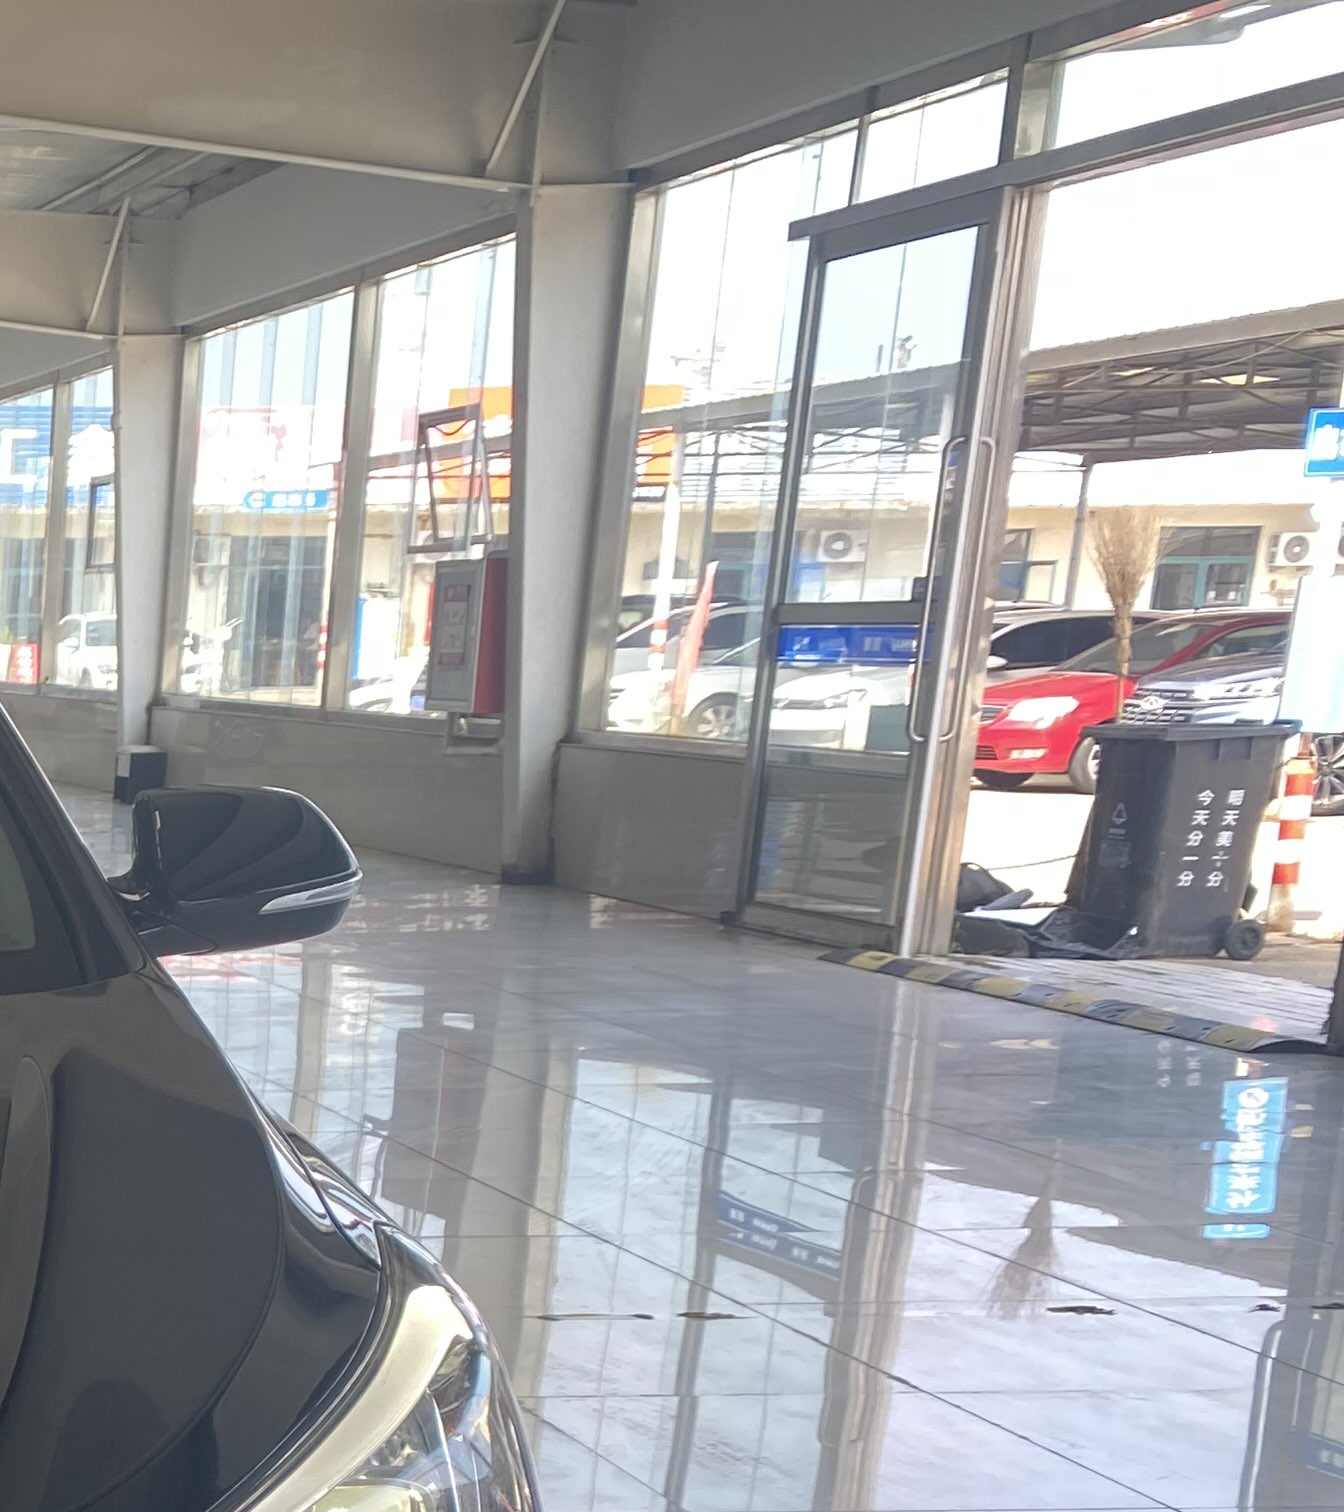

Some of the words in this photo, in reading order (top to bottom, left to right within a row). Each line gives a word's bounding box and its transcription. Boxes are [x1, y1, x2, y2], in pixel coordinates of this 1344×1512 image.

[1175, 788, 1216, 888] 今天分一分
